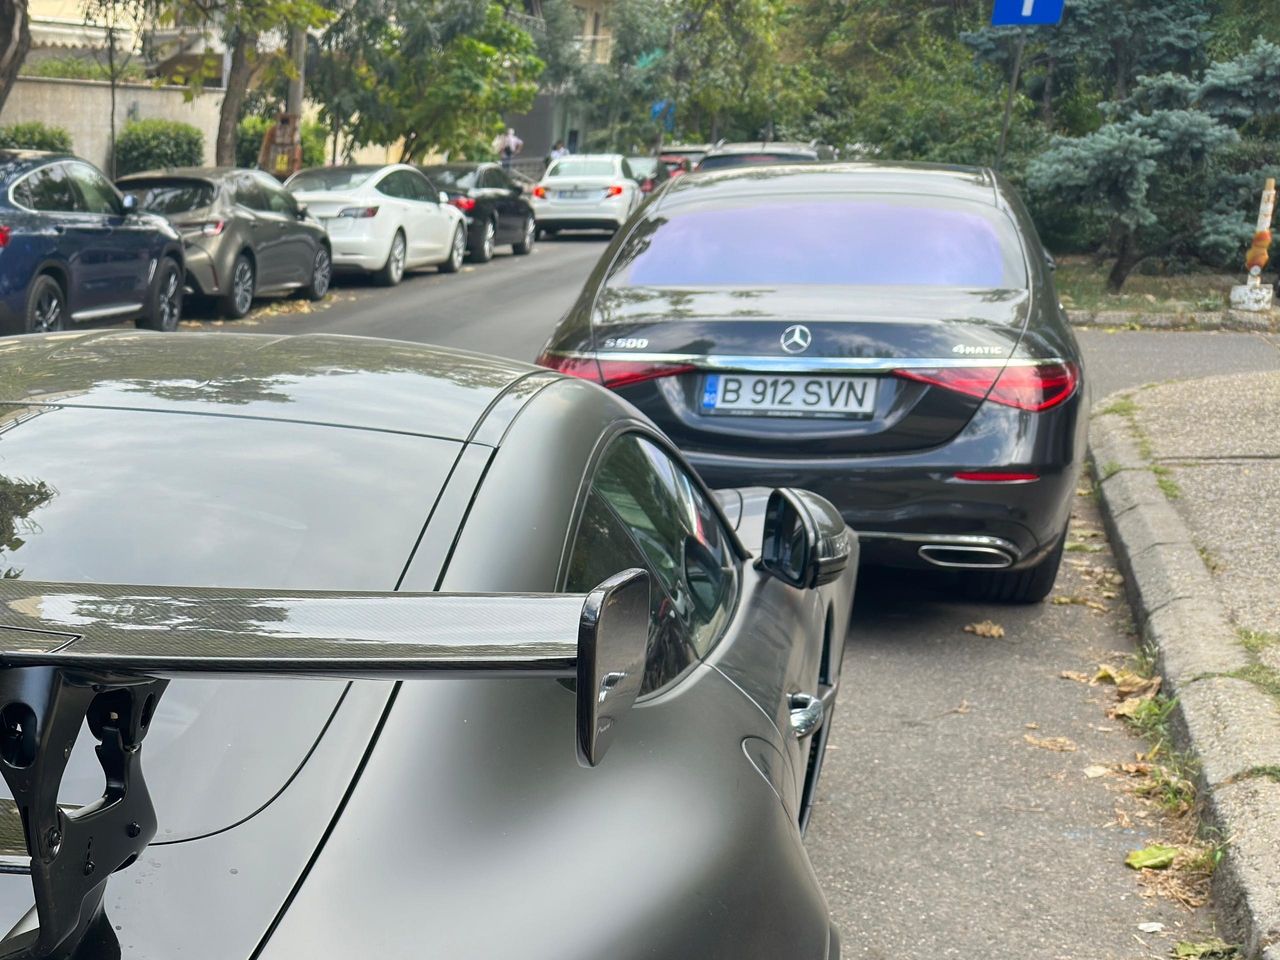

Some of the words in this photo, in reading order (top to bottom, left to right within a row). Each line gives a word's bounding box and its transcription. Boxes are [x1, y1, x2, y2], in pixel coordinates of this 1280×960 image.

[951, 343, 1003, 355] 4MATIC
[722, 378, 742, 404] B
[750, 379, 796, 405] 912
[802, 380, 868, 408] SVN
